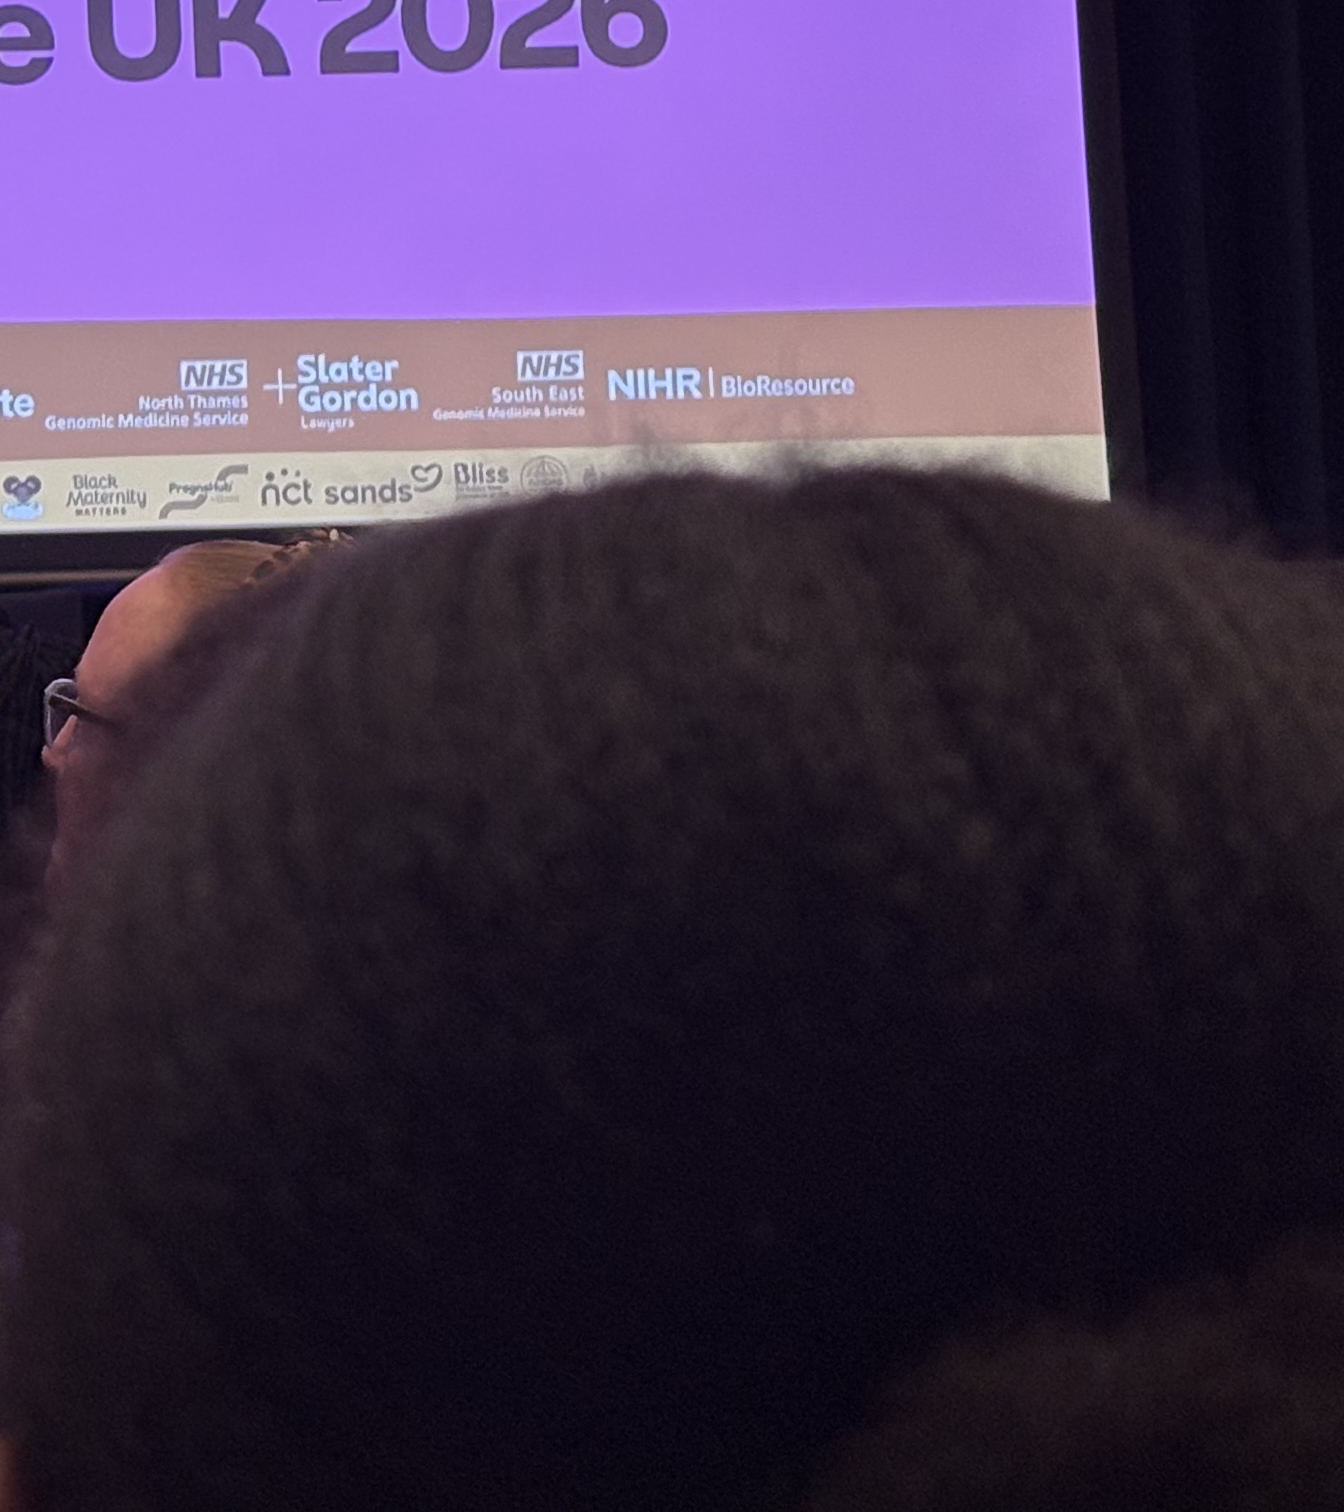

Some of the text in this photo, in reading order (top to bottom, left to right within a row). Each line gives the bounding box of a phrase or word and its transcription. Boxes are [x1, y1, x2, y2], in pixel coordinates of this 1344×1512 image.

[183, 363, 246, 387] NHS
[296, 353, 400, 383] Slater
[520, 354, 581, 379] NHS
[491, 384, 585, 404] South East
[607, 366, 855, 402] NIHR BioResource
[138, 393, 249, 412] North Thames
[297, 384, 419, 413] Gordon
[44, 412, 249, 431] Genomic Medicine Service
[300, 415, 355, 433] Lawyers
[72, 473, 119, 490] Black
[453, 462, 510, 485] Bliss
[66, 488, 147, 510] Maternity
[261, 477, 413, 506] nct sands
